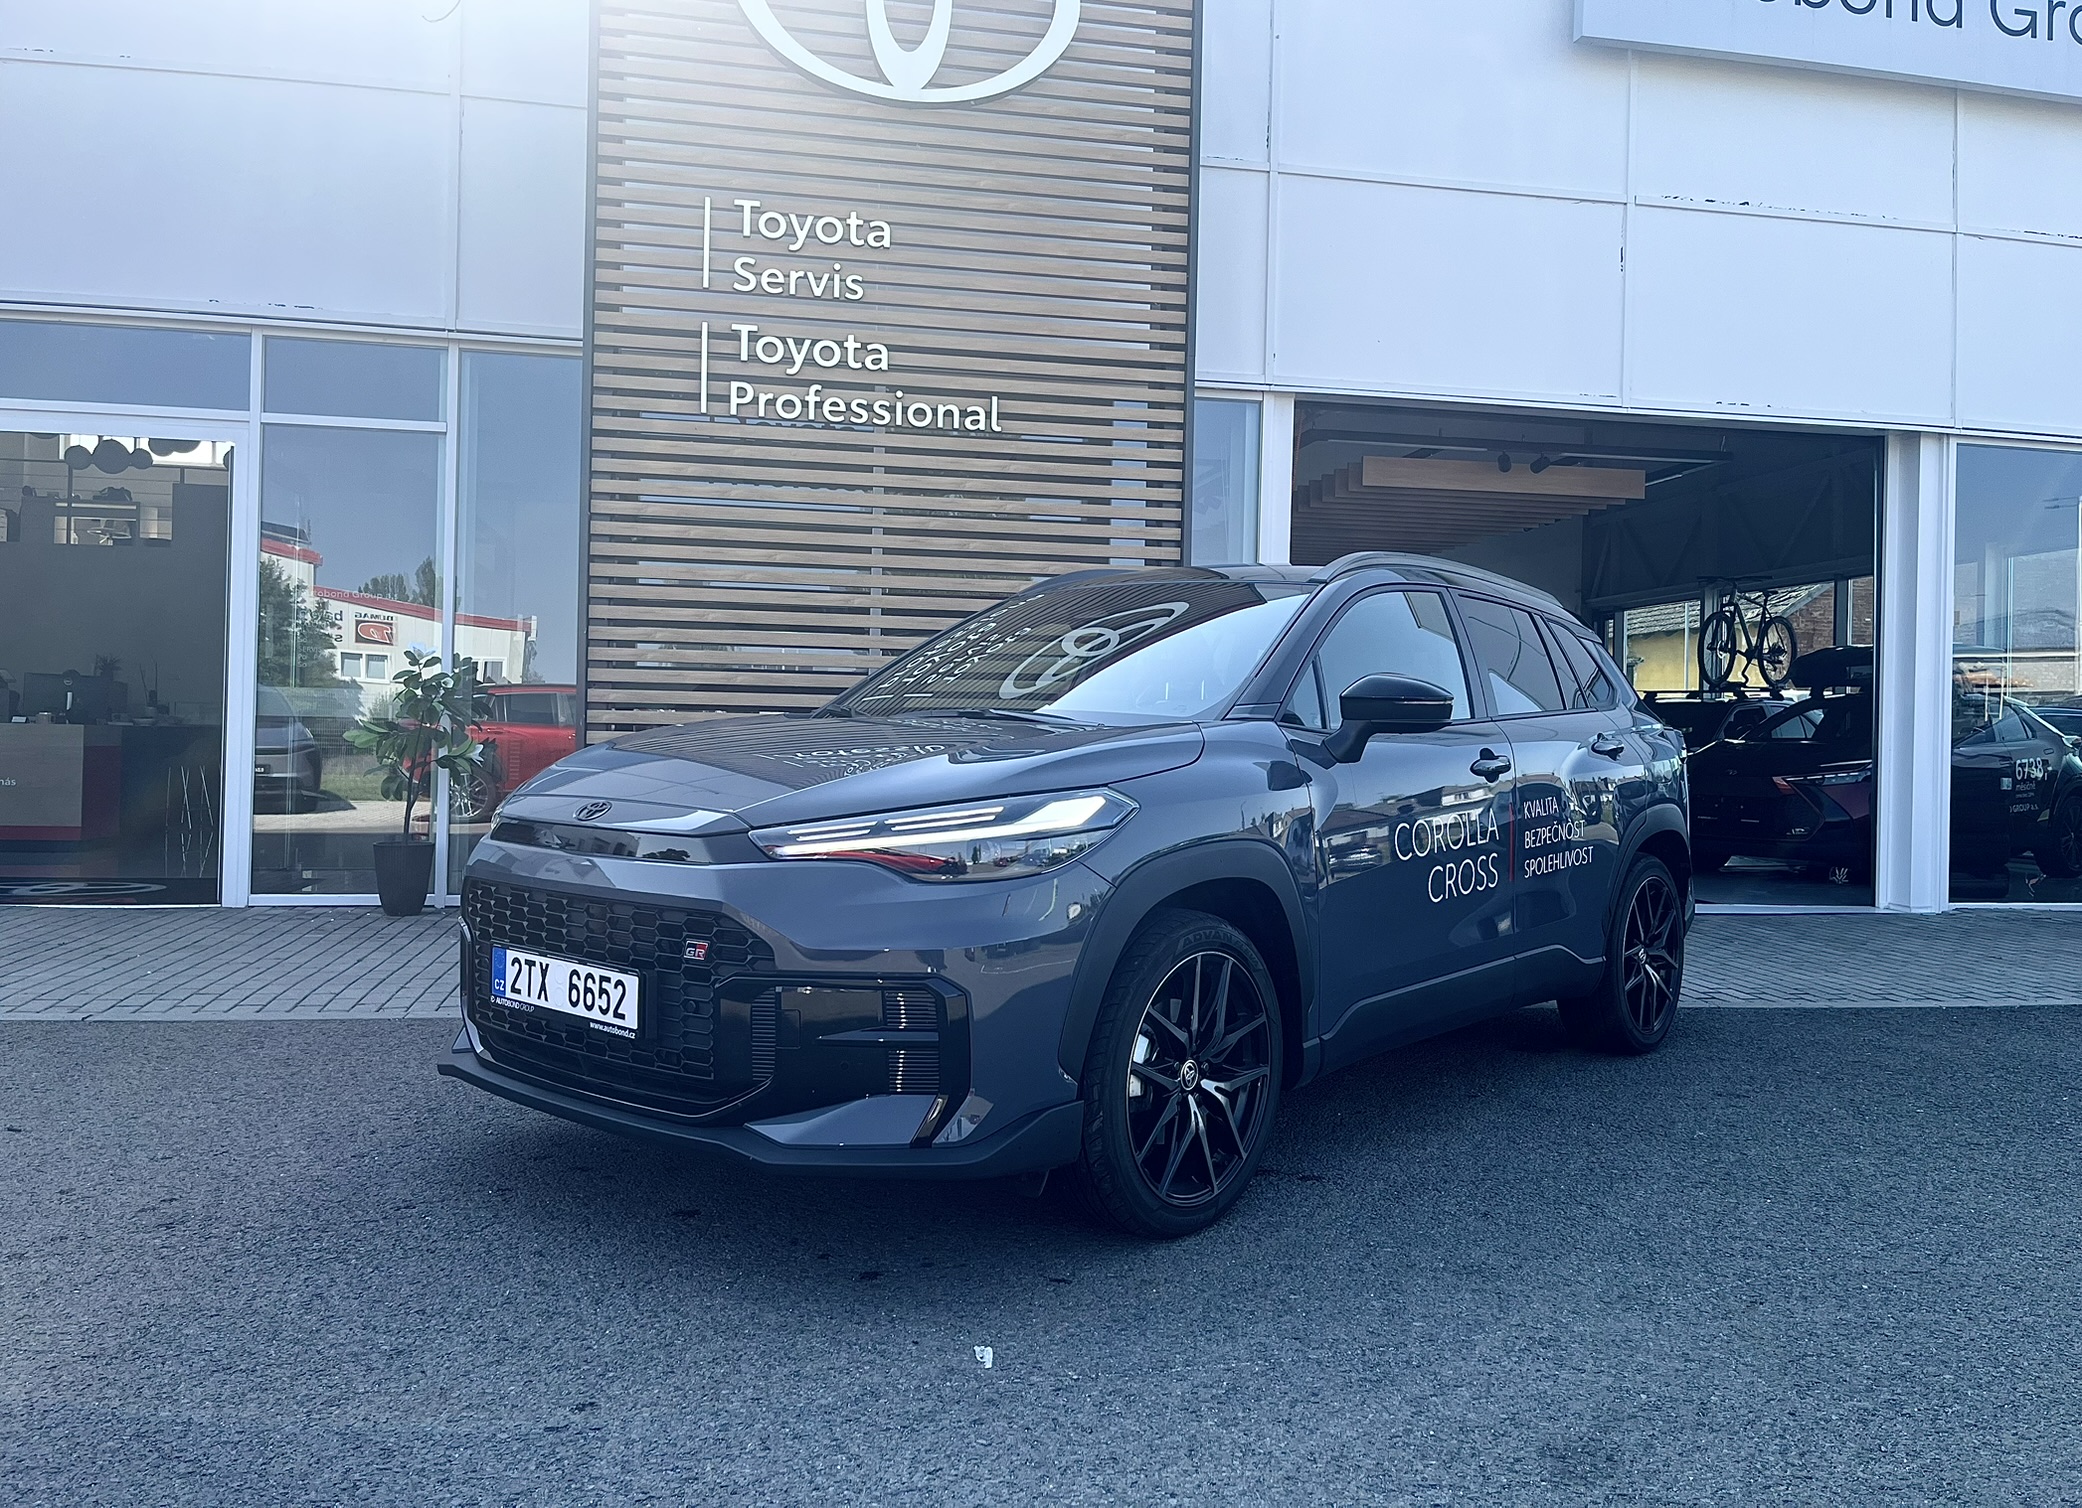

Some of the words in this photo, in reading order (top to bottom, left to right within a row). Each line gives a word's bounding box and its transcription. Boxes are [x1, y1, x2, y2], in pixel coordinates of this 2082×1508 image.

[733, 199, 891, 251] Toyota
[732, 256, 864, 300] Servis
[731, 323, 889, 375] Toyota
[729, 381, 1002, 432] Professional
[1523, 796, 1559, 819] KVALITA
[1394, 807, 1500, 861] COROLLA
[1524, 819, 1586, 849] BEZPEČNOST
[1427, 852, 1499, 903] CROSS
[1524, 845, 1594, 879] SPOLEHLIVOST
[686, 947, 705, 958] GR
[494, 978, 505, 991] CZ
[510, 956, 550, 1002] 2TX
[568, 968, 626, 1021] 6652
[590, 1021, 636, 1039] www.autobond.cz
